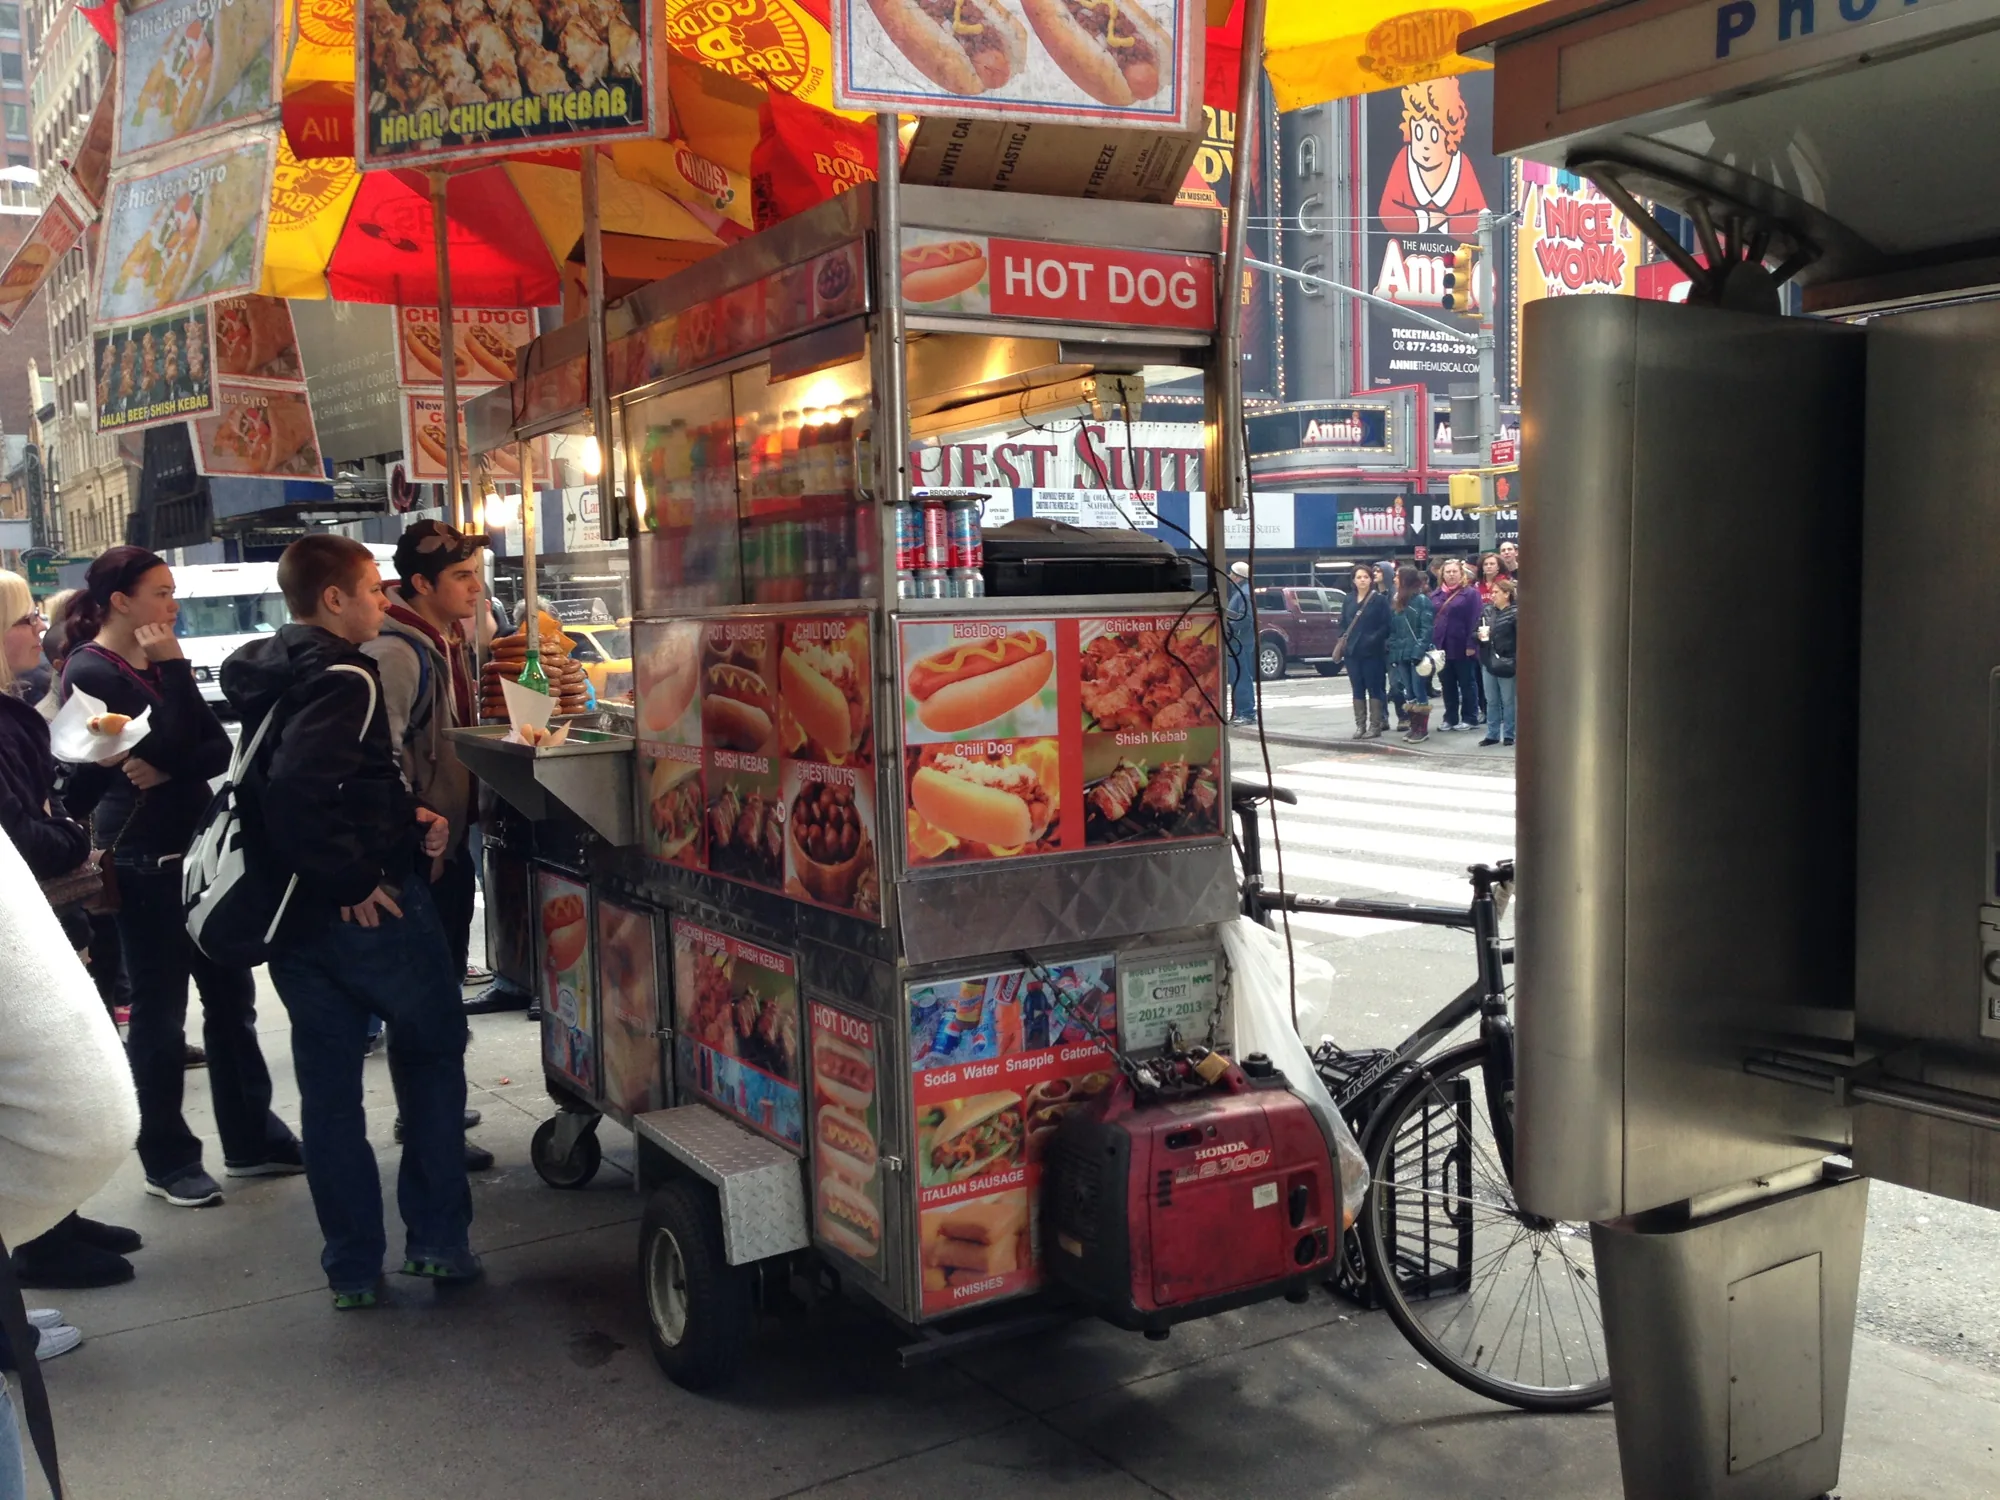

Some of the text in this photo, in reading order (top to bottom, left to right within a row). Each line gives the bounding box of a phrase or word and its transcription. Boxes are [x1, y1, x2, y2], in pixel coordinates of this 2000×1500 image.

[130, 0, 234, 42] Chicken Gyro
[1716, 0, 1918, 59] PHO
[380, 86, 628, 146] HALAL CHICKEN KEBAB
[301, 117, 339, 142] All
[813, 152, 878, 184] ROYA
[940, 142, 964, 179] WITH
[996, 133, 1027, 183] PLASTIC
[1090, 143, 1118, 188] FREEZE
[187, 163, 227, 193] Gyro
[1187, 192, 1213, 202] MUSICAL
[1543, 196, 1614, 245] NICE
[1402, 239, 1454, 254] THE MUSICAL
[1535, 238, 1626, 290] WORK
[1004, 256, 1094, 301] HOT
[1108, 264, 1198, 310] DOG
[405, 307, 528, 325] CHLI DOG
[1392, 340, 1405, 351] OR
[99, 394, 210, 428] HALAL BEEF SHISH KEBAB
[240, 391, 270, 408] Gyro
[416, 400, 442, 411] New
[1303, 418, 1362, 444] Annie
[1074, 424, 1206, 492] SUIT
[1129, 492, 1155, 500] DANGER
[1353, 506, 1405, 535] Annie
[1431, 504, 1465, 521] BOX
[708, 623, 766, 641] HOT SAUSAGE
[796, 622, 847, 640] CHILI DOG
[954, 624, 1008, 639] Hot Dog
[1105, 619, 1152, 633] Chicken
[954, 741, 1013, 757] Chili Dog
[1115, 730, 1188, 746] Shish Kebab
[714, 750, 769, 775] SHISH KEBAB
[796, 762, 856, 787] CHESTNUTS
[703, 932, 726, 951] KEBAB
[737, 944, 785, 973] SHISH KEBAB
[1152, 984, 1187, 1000] C7907
[1139, 1000, 1203, 1022] 2012 2013
[813, 1004, 869, 1044] HOT DOG
[924, 1040, 1108, 1088] Soda Water Snapple Gatorad
[1195, 1140, 1249, 1161] HONDA
[922, 1169, 1024, 1204] ITALIAN SAUSAGE
[953, 1276, 1004, 1300] KNISHES
